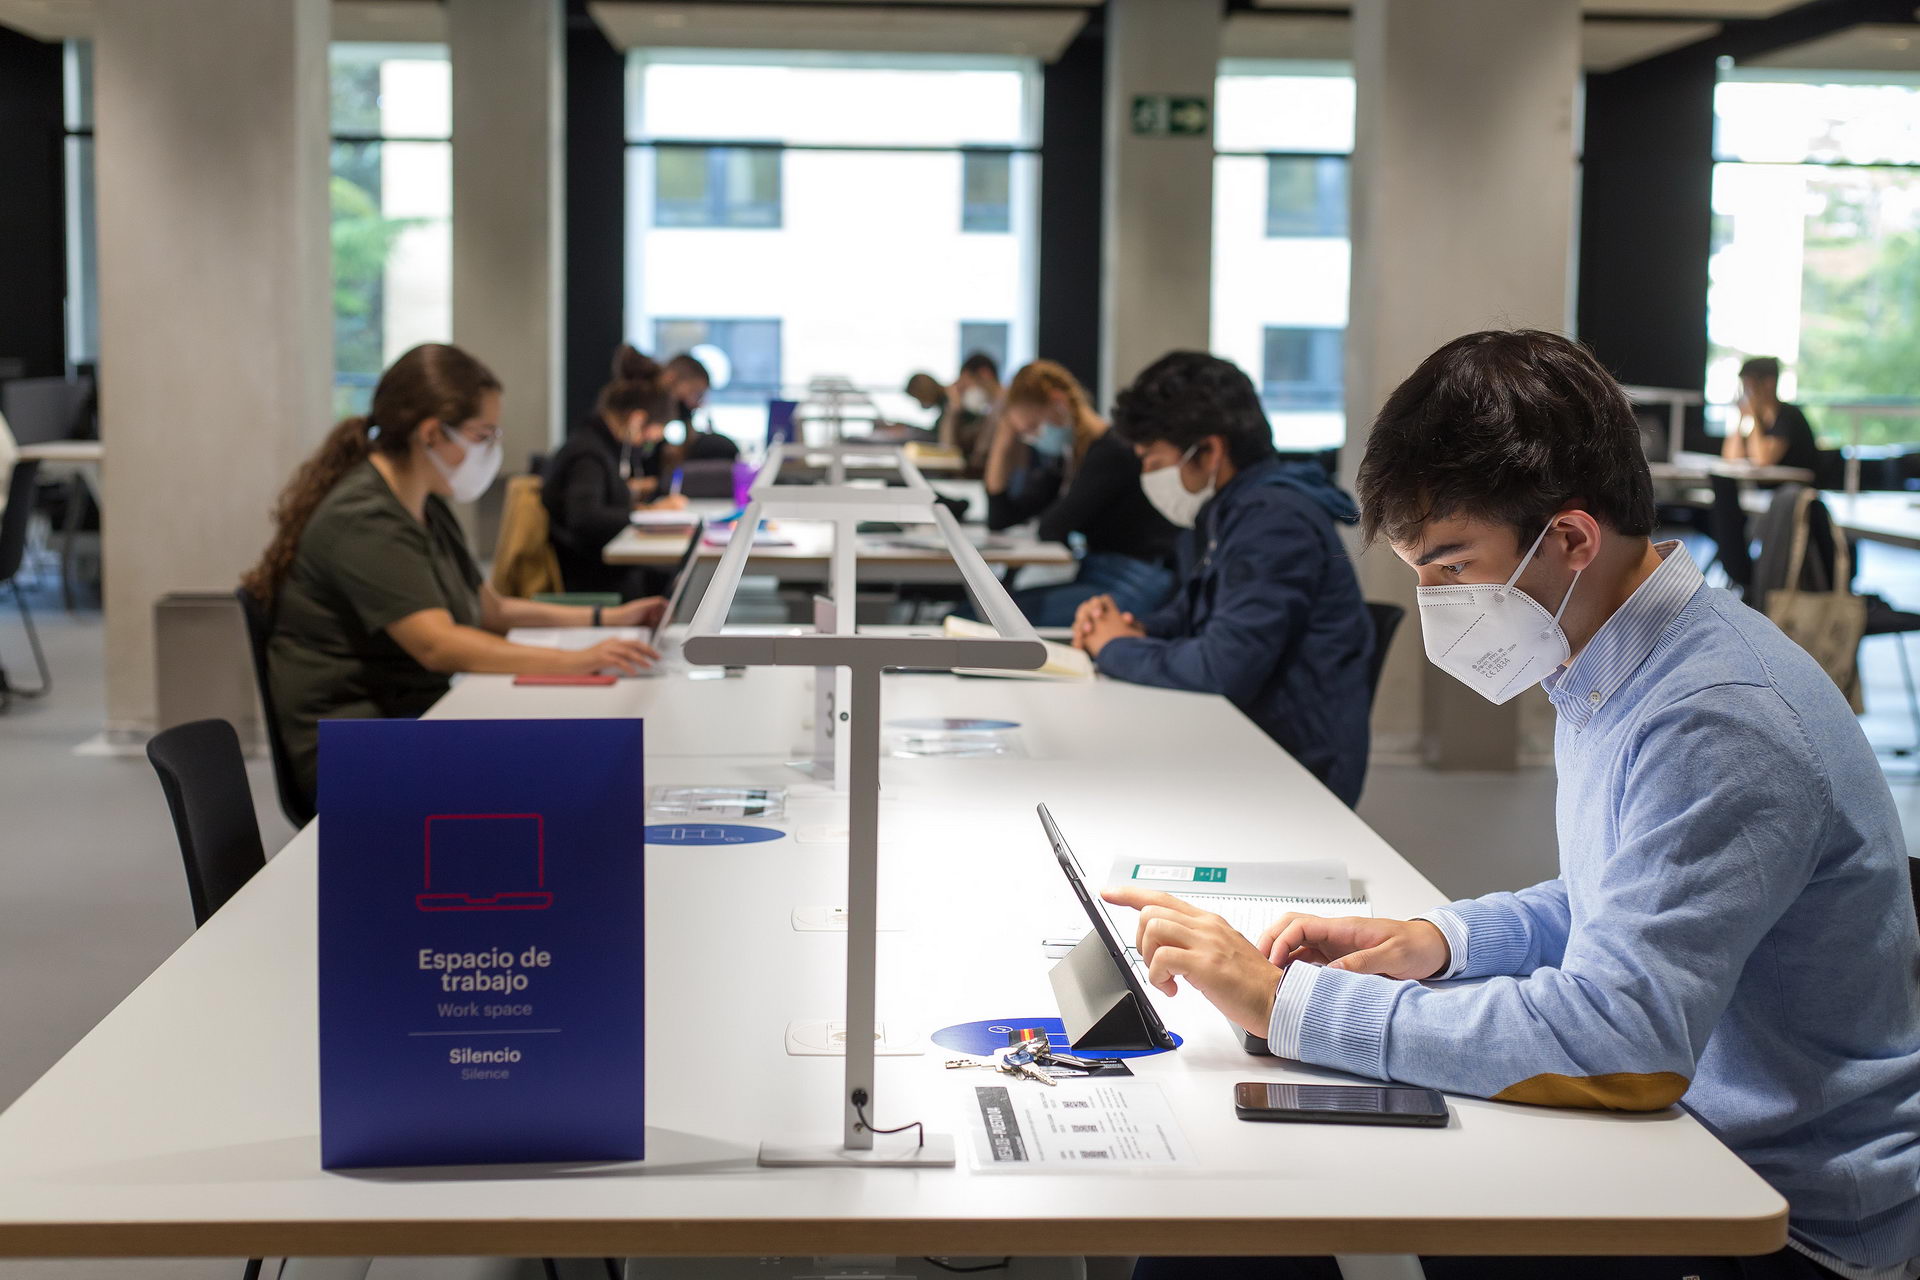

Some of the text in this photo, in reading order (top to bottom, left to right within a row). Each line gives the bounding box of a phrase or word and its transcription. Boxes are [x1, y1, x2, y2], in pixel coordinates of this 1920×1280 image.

[419, 945, 552, 973] Espacio de
[441, 969, 529, 995] trabajo
[437, 1001, 533, 1019] Work space
[449, 1047, 521, 1064] Silencio
[461, 1067, 510, 1081] Silence
